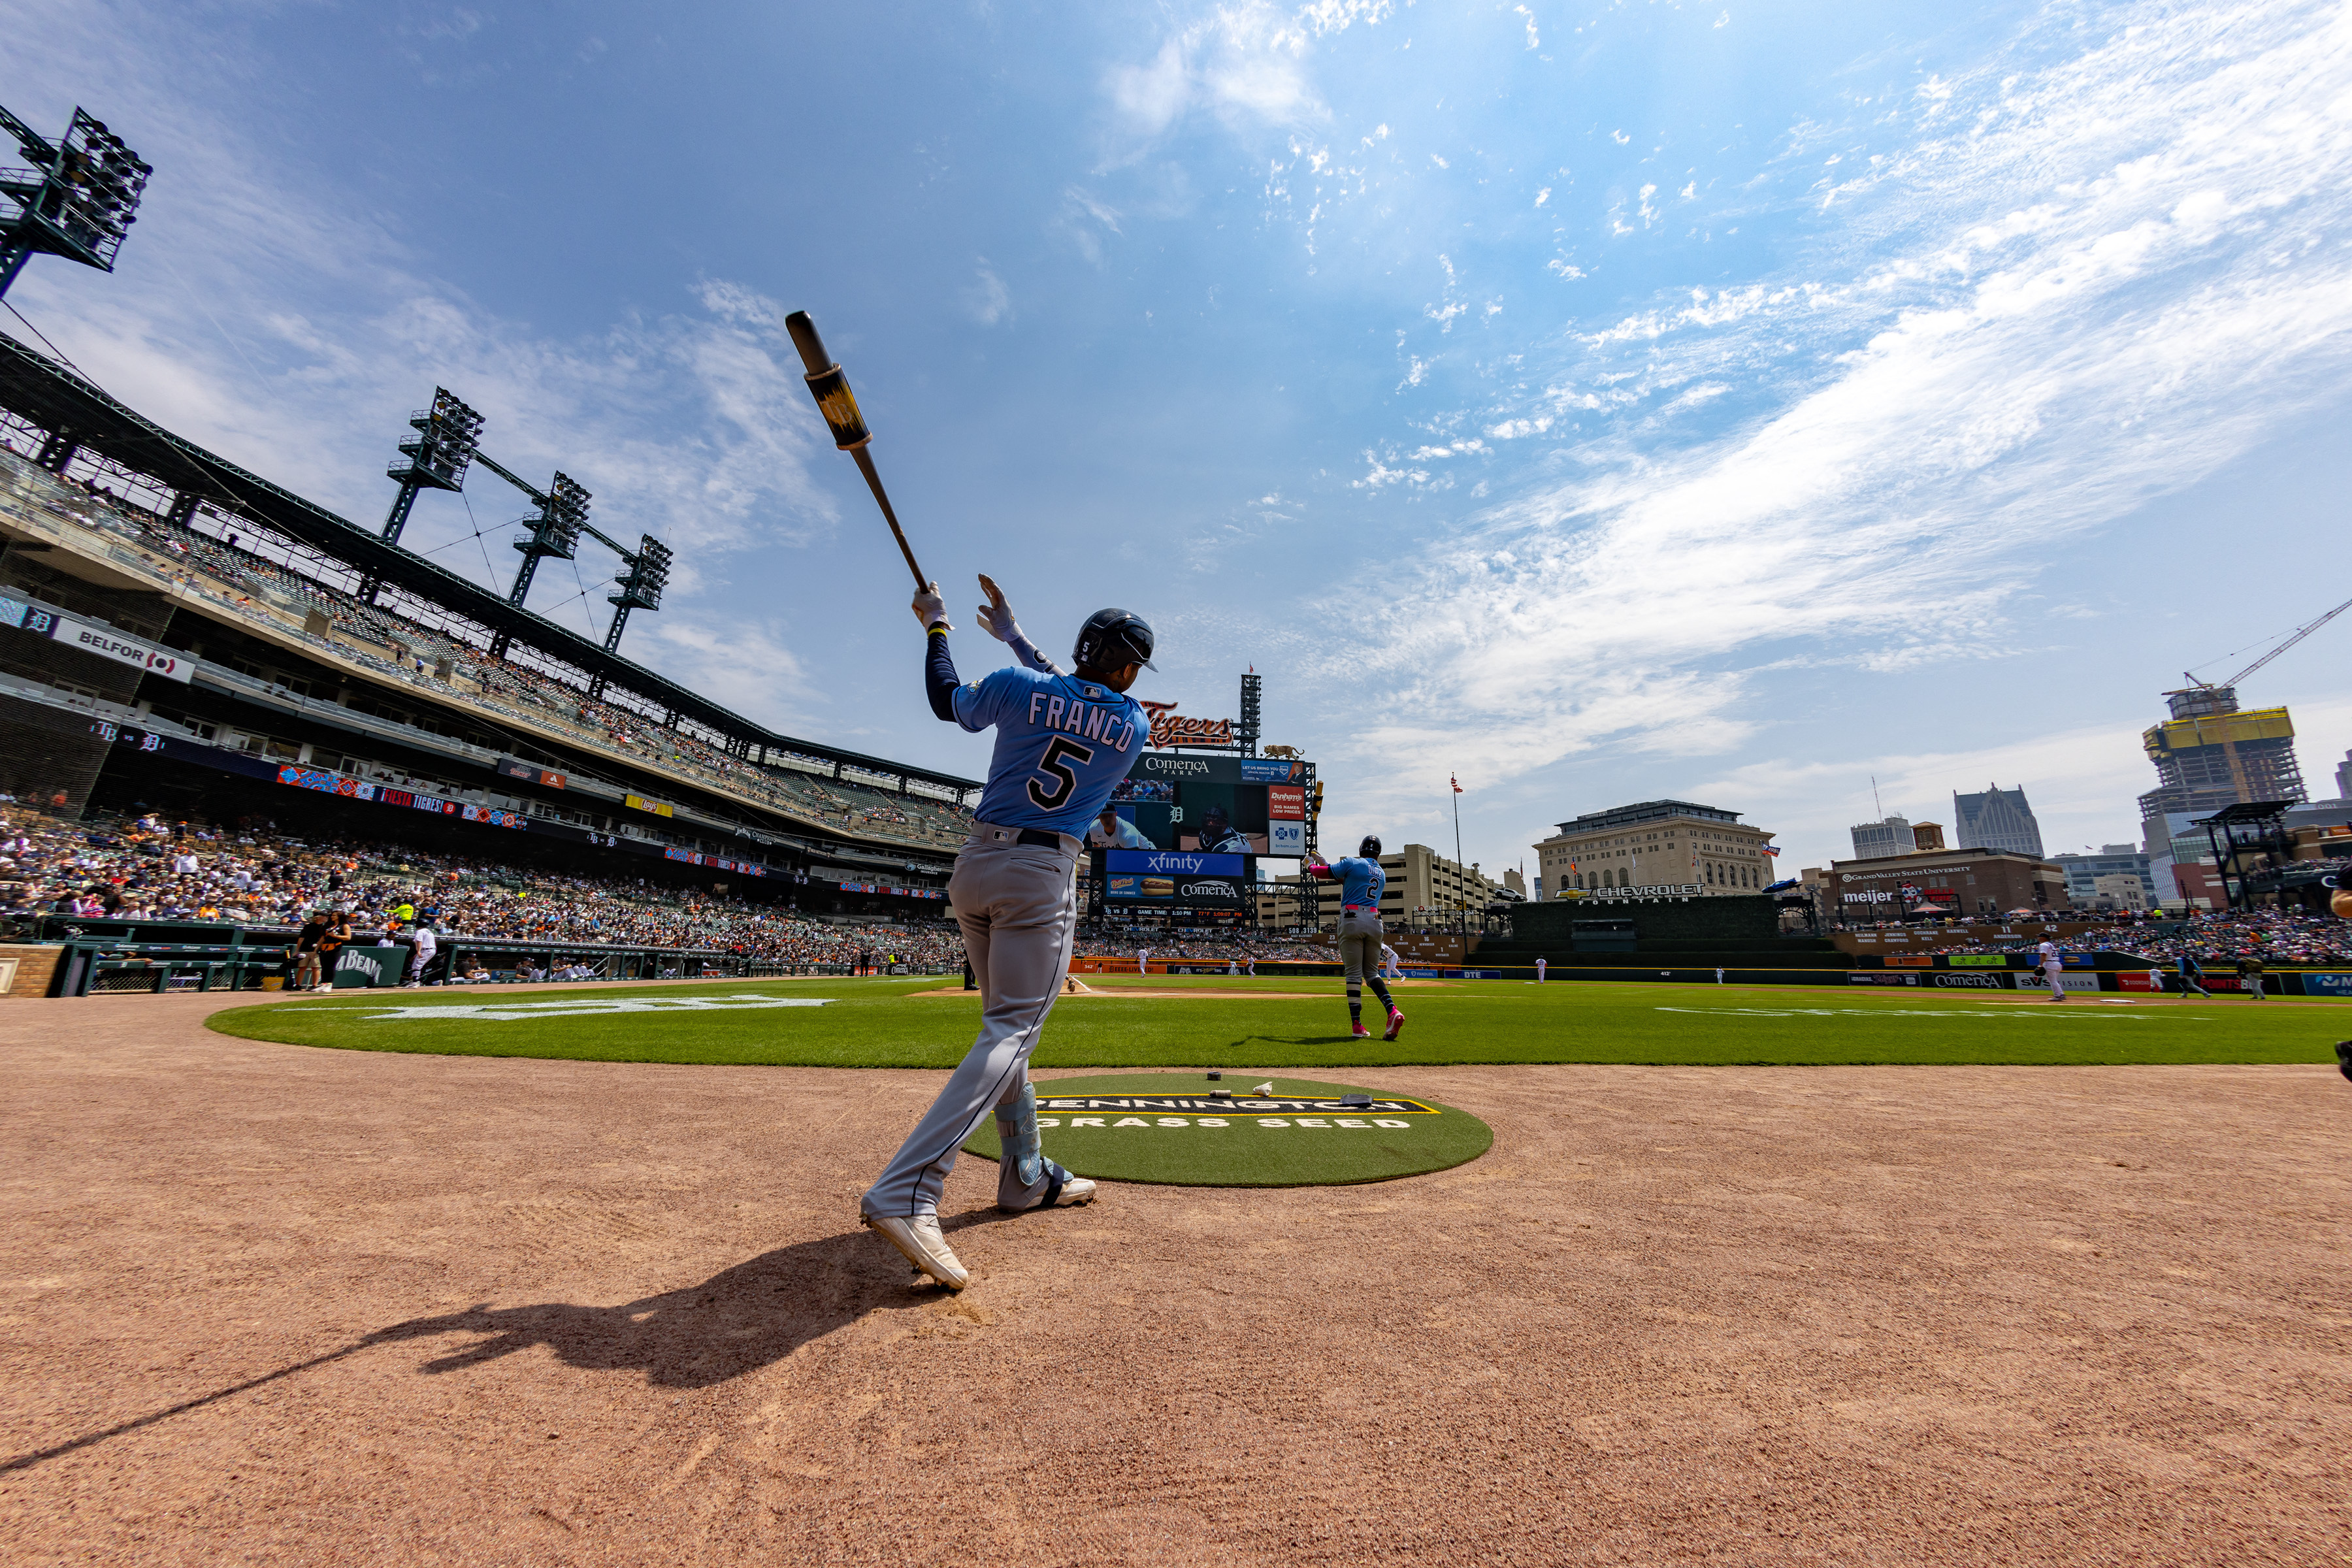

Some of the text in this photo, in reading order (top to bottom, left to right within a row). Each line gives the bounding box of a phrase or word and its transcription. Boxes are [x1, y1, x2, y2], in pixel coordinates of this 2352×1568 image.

[78, 631, 144, 662] BELFOR
[1082, 642, 1090, 653] 5
[1028, 691, 1135, 753] FRANCO
[1139, 700, 1233, 751] Tigers
[510, 768, 532, 779] TICKET
[1026, 734, 1095, 812] 5
[380, 788, 412, 807] ¡FIESTA
[413, 794, 444, 813] TIGRES!
[1271, 792, 1302, 800] Dunham's
[642, 800, 657, 811] Lay's
[751, 831, 777, 843] CHAMPIONS
[917, 864, 942, 872] Gallagher
[1147, 853, 1203, 873] xfinity
[1923, 866, 1971, 875] UNIVERSITY
[1365, 877, 1380, 900] 2
[1596, 883, 1705, 897] CHEVROLET
[1578, 897, 1690, 906] FOUNTAIN
[1844, 889, 1893, 904] meijer
[345, 949, 383, 983] BEAM
[1036, 1118, 1411, 1128] GRASS SEED
